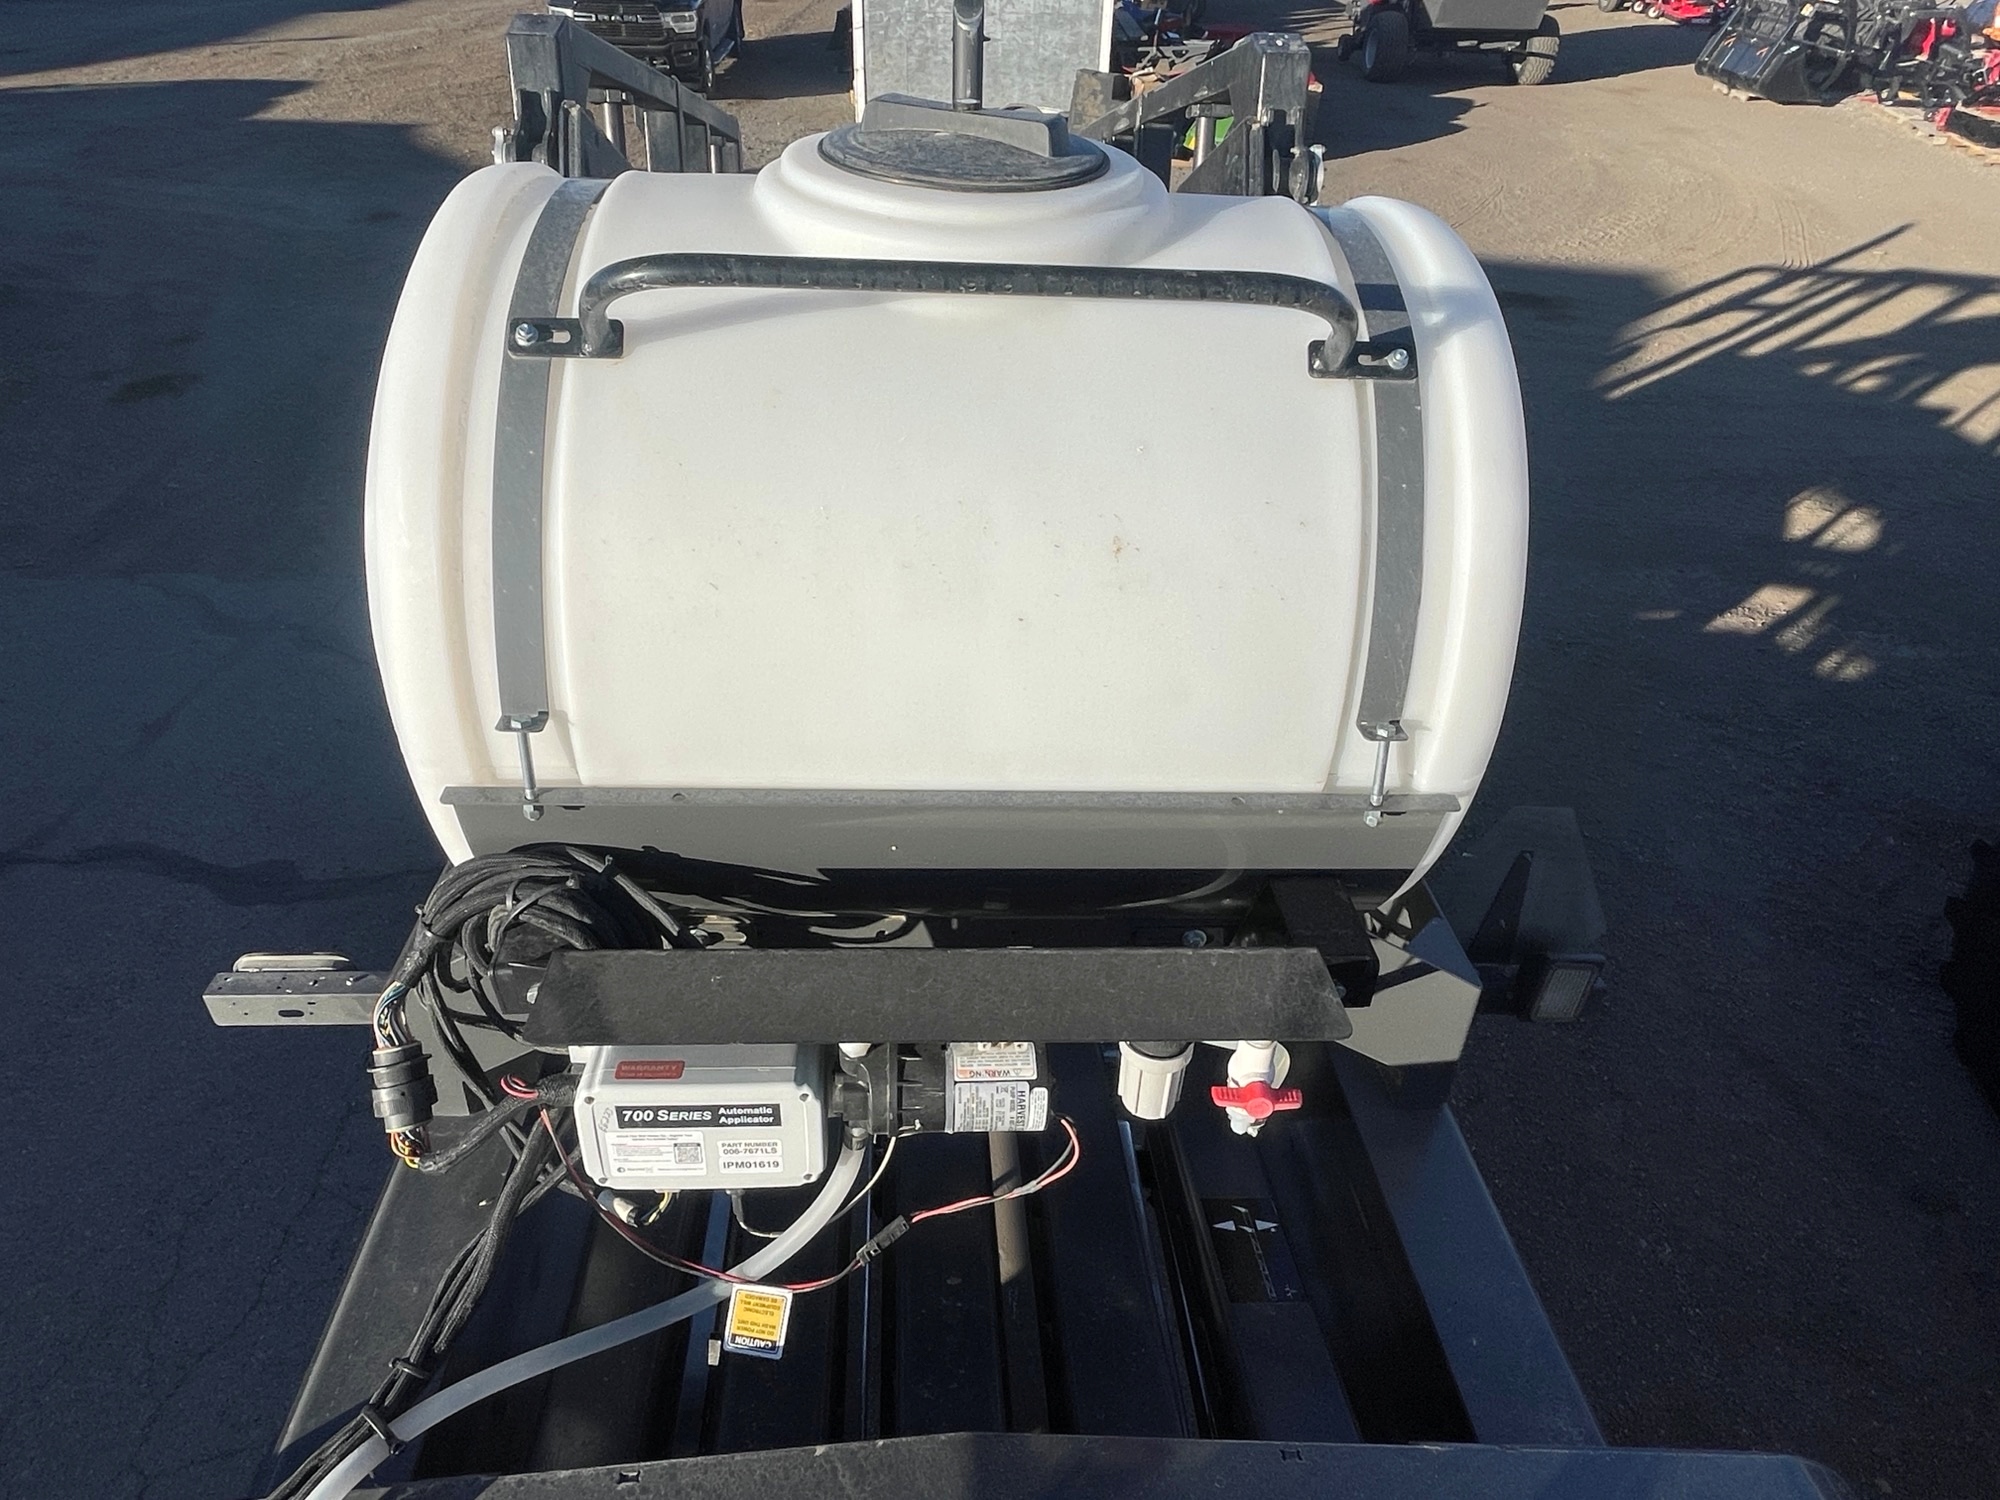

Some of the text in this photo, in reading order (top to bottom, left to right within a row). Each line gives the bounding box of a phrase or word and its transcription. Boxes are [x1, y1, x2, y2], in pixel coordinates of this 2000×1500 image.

[969, 1069, 1010, 1077] WARNNG
[718, 1106, 773, 1115] Automatic
[1016, 1090, 1026, 1127] HARVEST
[622, 1109, 654, 1121] 700
[719, 1115, 775, 1125] Applicator
[723, 1160, 780, 1169] IPM01619
[743, 1306, 775, 1317] ELECTRONIC
[752, 1303, 781, 1312] EQUIPMENT
[736, 1325, 755, 1334] POWER
[735, 1336, 772, 1348] CAUTION
